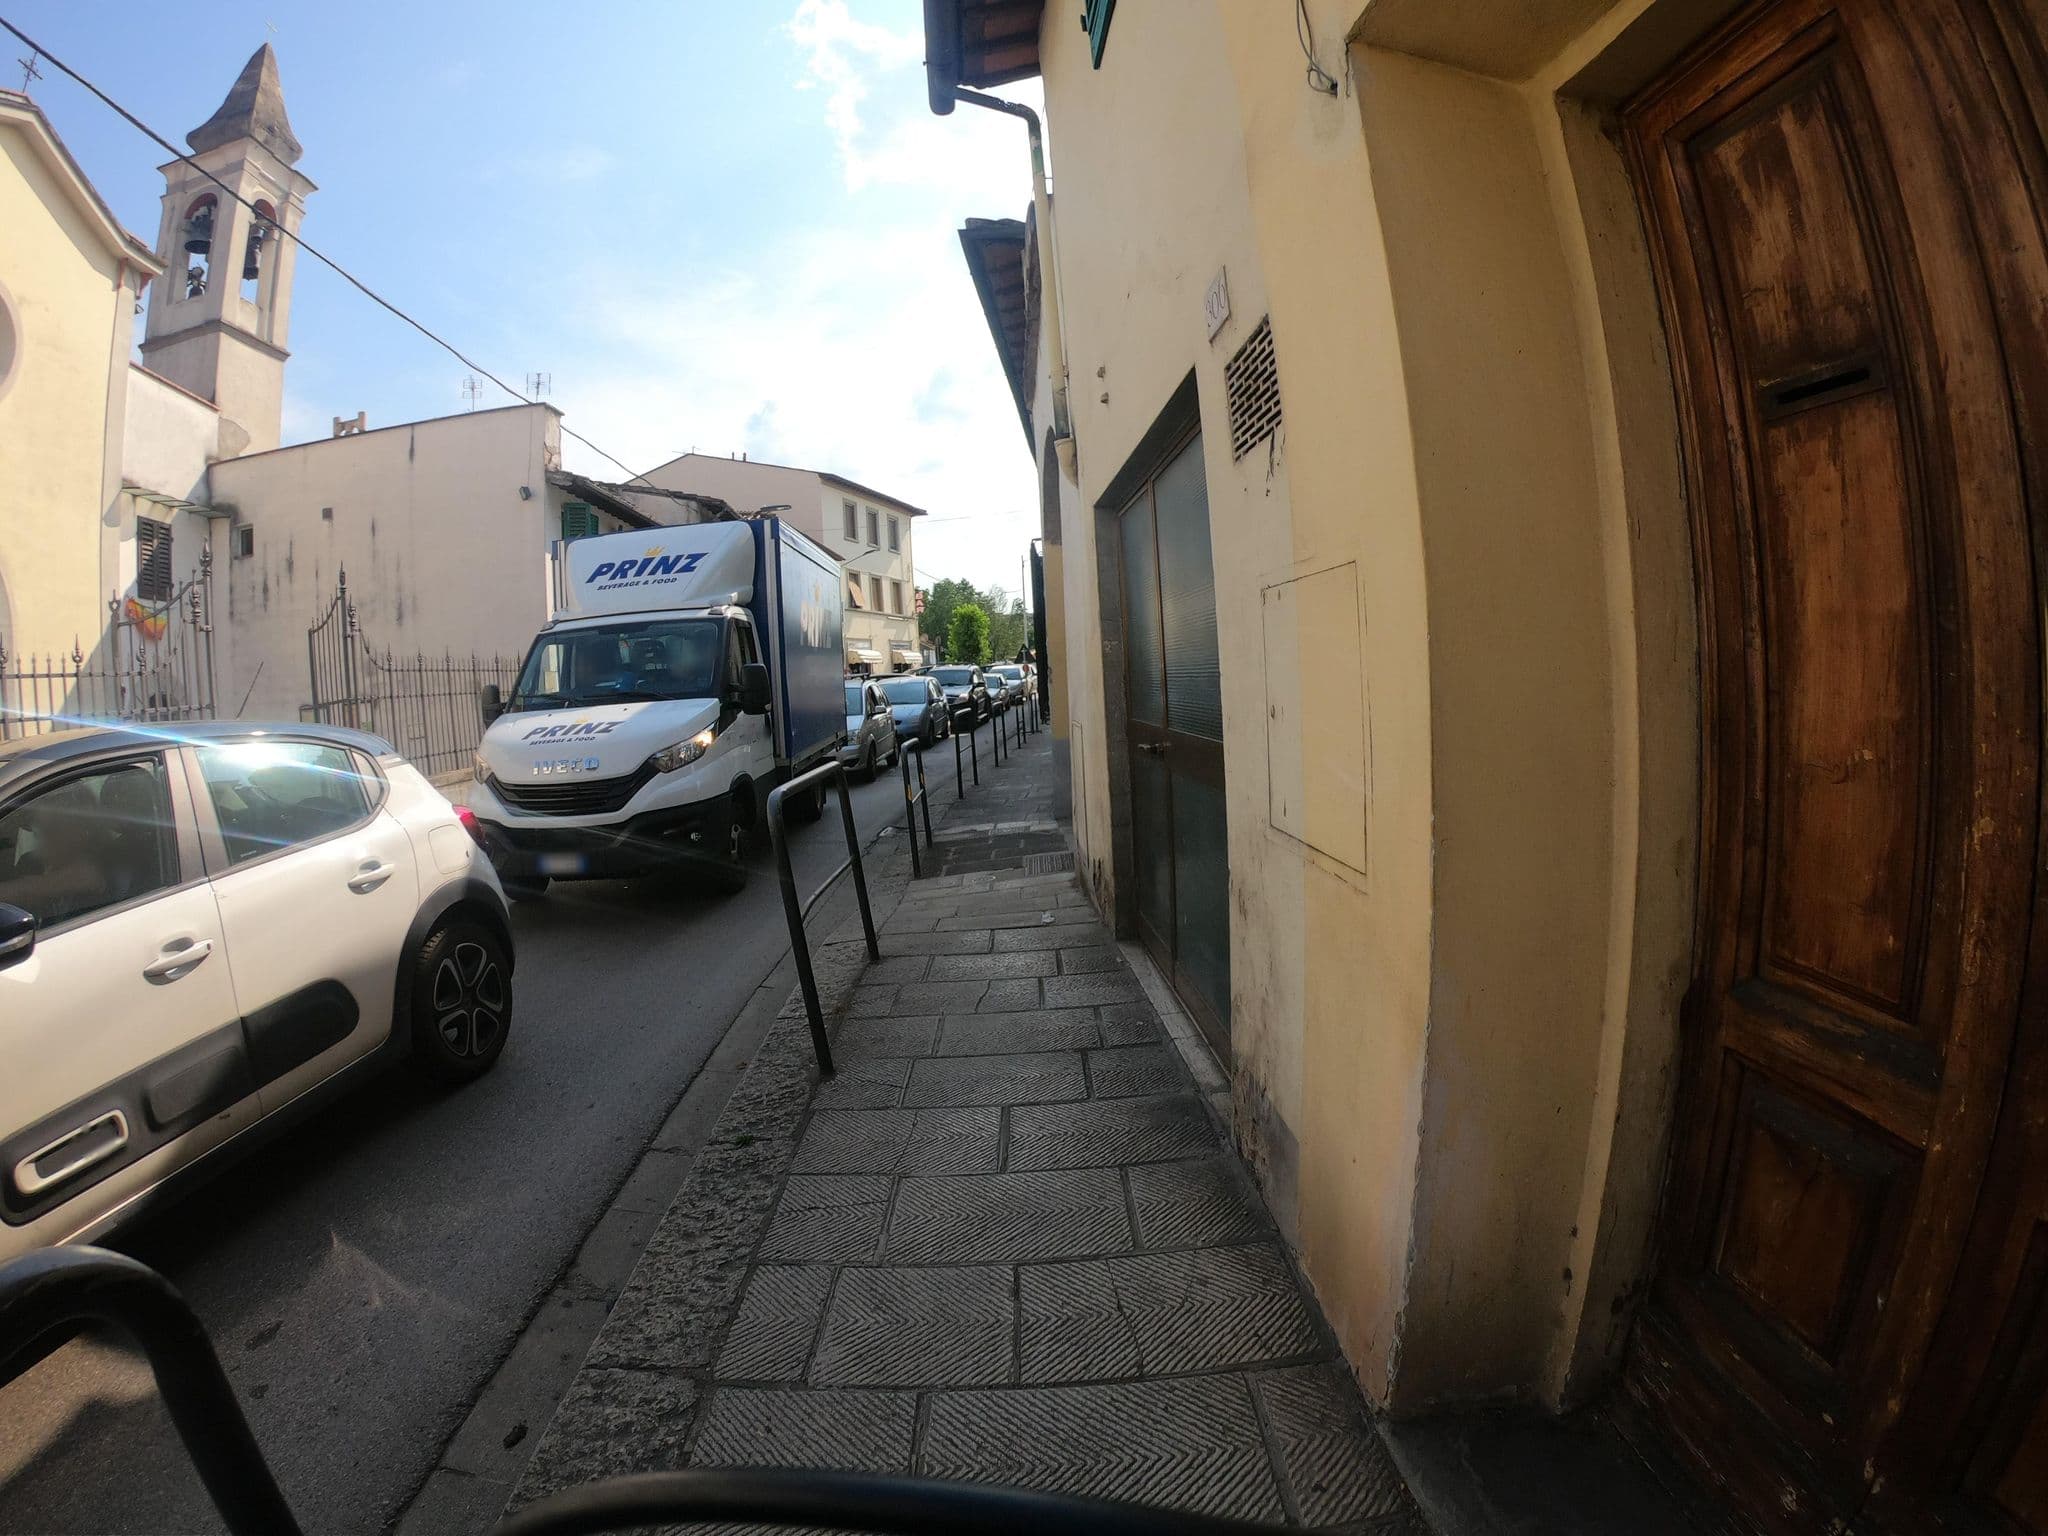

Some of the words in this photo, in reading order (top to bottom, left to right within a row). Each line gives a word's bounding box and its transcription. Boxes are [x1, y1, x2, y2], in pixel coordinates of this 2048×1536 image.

[585, 552, 709, 584] PRINZ
[597, 580, 641, 591] BEVERAGE
[521, 721, 625, 740] PRINZ
[529, 738, 565, 746] BEVERAGE
[531, 757, 600, 776] IVECO
